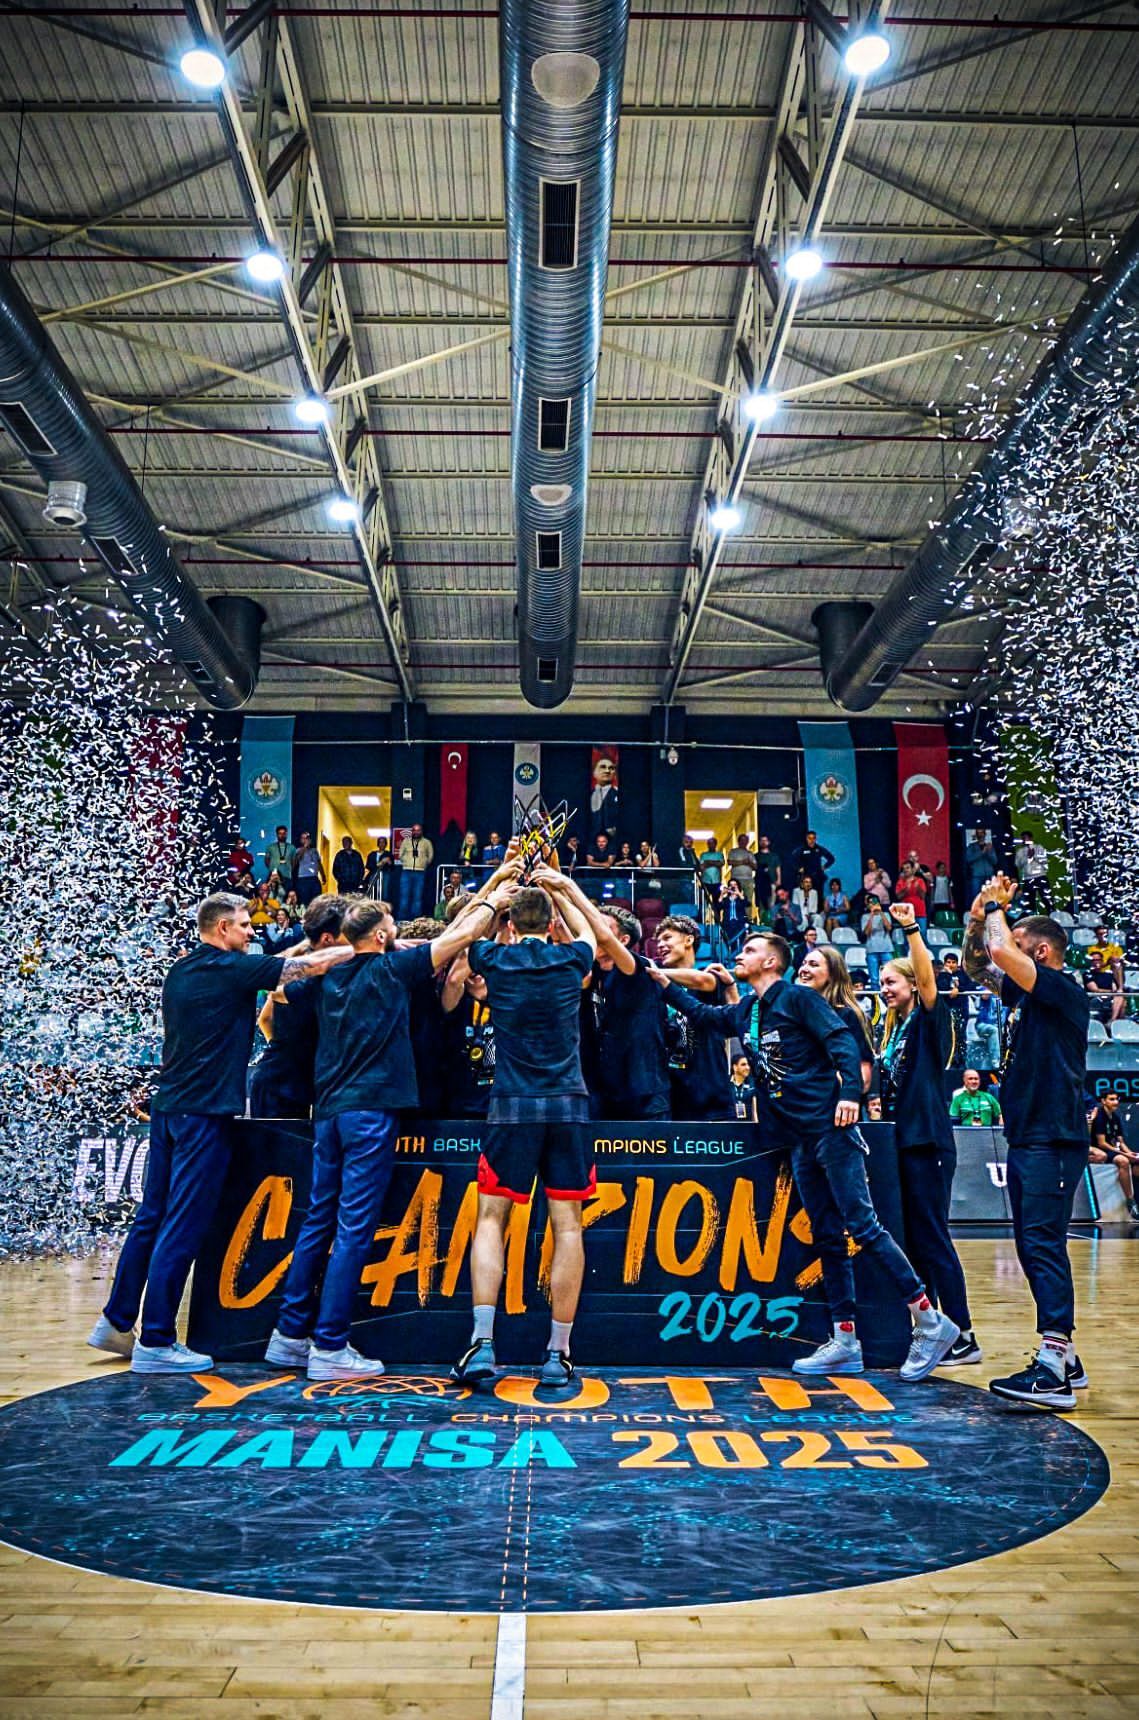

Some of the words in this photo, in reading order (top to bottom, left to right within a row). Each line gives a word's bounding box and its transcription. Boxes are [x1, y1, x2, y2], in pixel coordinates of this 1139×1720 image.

[594, 1139, 667, 1154] MPIONS
[673, 1140, 745, 1154] LEAGUE
[219, 1161, 863, 1314] CAMPIONS
[658, 1290, 804, 1343] 2025
[136, 1412, 432, 1423] BASKETBALL
[450, 1412, 725, 1424] CHAMPIONS
[743, 1413, 921, 1424] LEAGUE
[108, 1429, 578, 1468] MANISA
[611, 1430, 929, 1470] 2025
